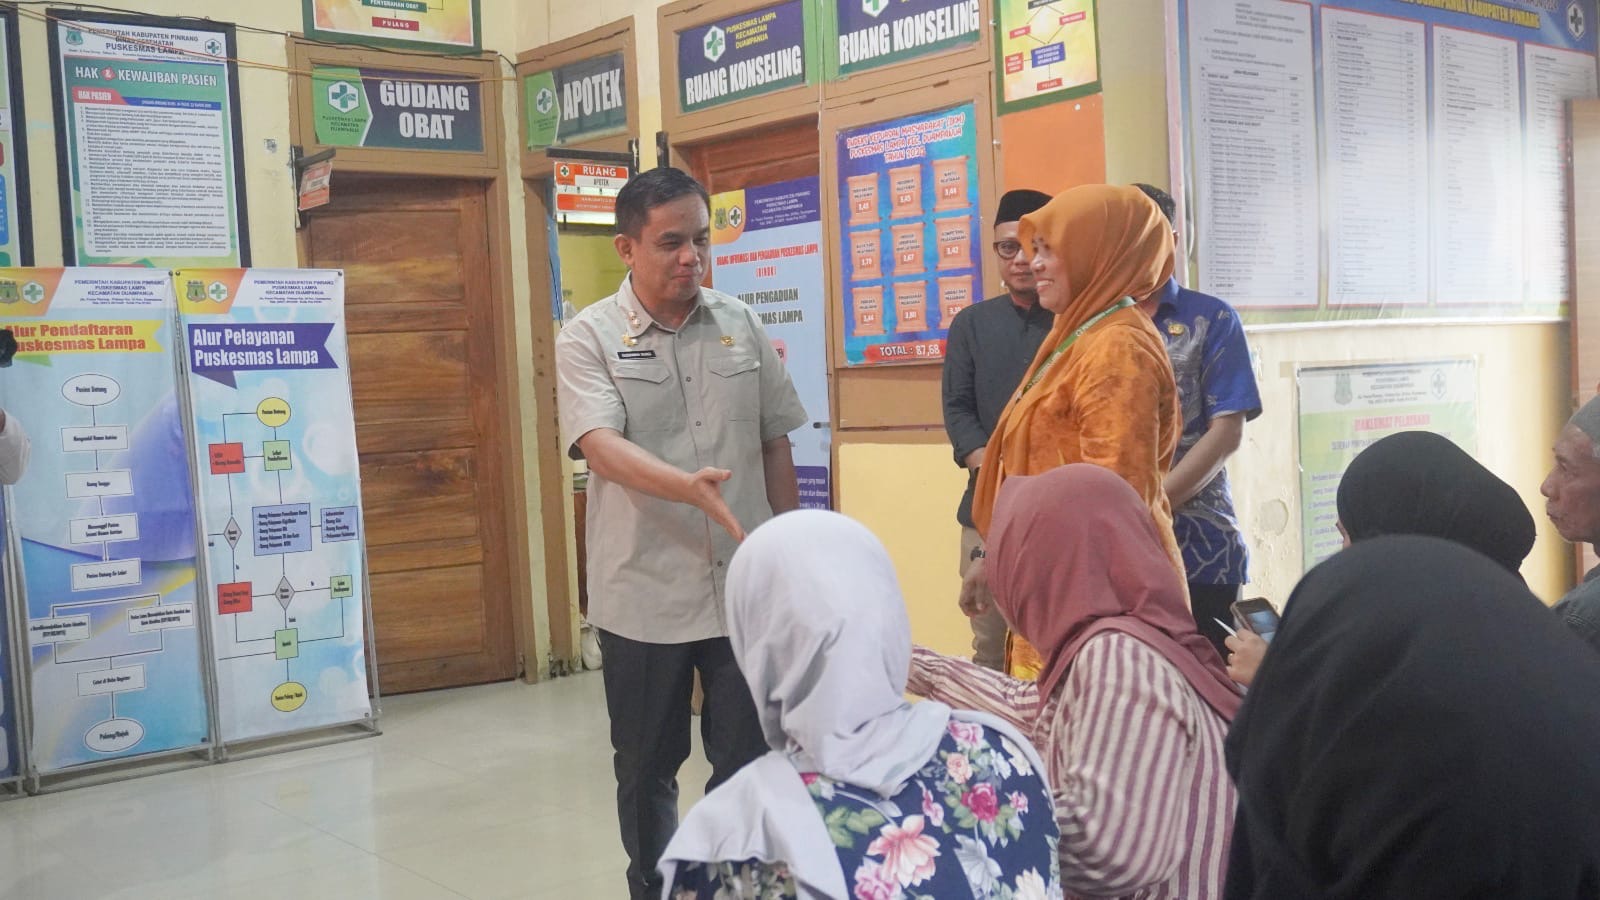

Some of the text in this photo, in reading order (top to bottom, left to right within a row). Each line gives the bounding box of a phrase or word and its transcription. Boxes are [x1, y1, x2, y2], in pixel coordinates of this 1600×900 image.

[726, 12, 777, 33] PUSKESMAS LAMPA
[132, 32, 170, 40] KABUPATEN
[736, 24, 768, 40] KECAMATAN
[840, 0, 980, 65] RUANG KONSELING
[106, 42, 156, 53] PUSKESMAS
[736, 33, 768, 49] DUAMPANUA
[76, 66, 98, 79] HAK
[118, 70, 178, 84] KEWAJIBAN
[182, 74, 217, 87] PASIEN
[686, 45, 802, 105] RUANG KONSELING
[380, 80, 470, 111] GUDANG
[564, 68, 622, 120] APOTEK
[399, 112, 454, 140] OBAT
[850, 144, 884, 159] PUSKESMAS
[583, 166, 616, 177] RUANG
[756, 288, 799, 305] PENGADUAN
[779, 310, 803, 324] LAMPA
[6, 324, 133, 337] Alur Pendaftaran
[194, 328, 294, 347] Alur Pelayanan
[16, 338, 146, 352] uskesmas Lampa
[880, 346, 907, 356] TOTAL
[916, 344, 940, 356] 87,68
[195, 348, 319, 366] Puskesmas Lampa
